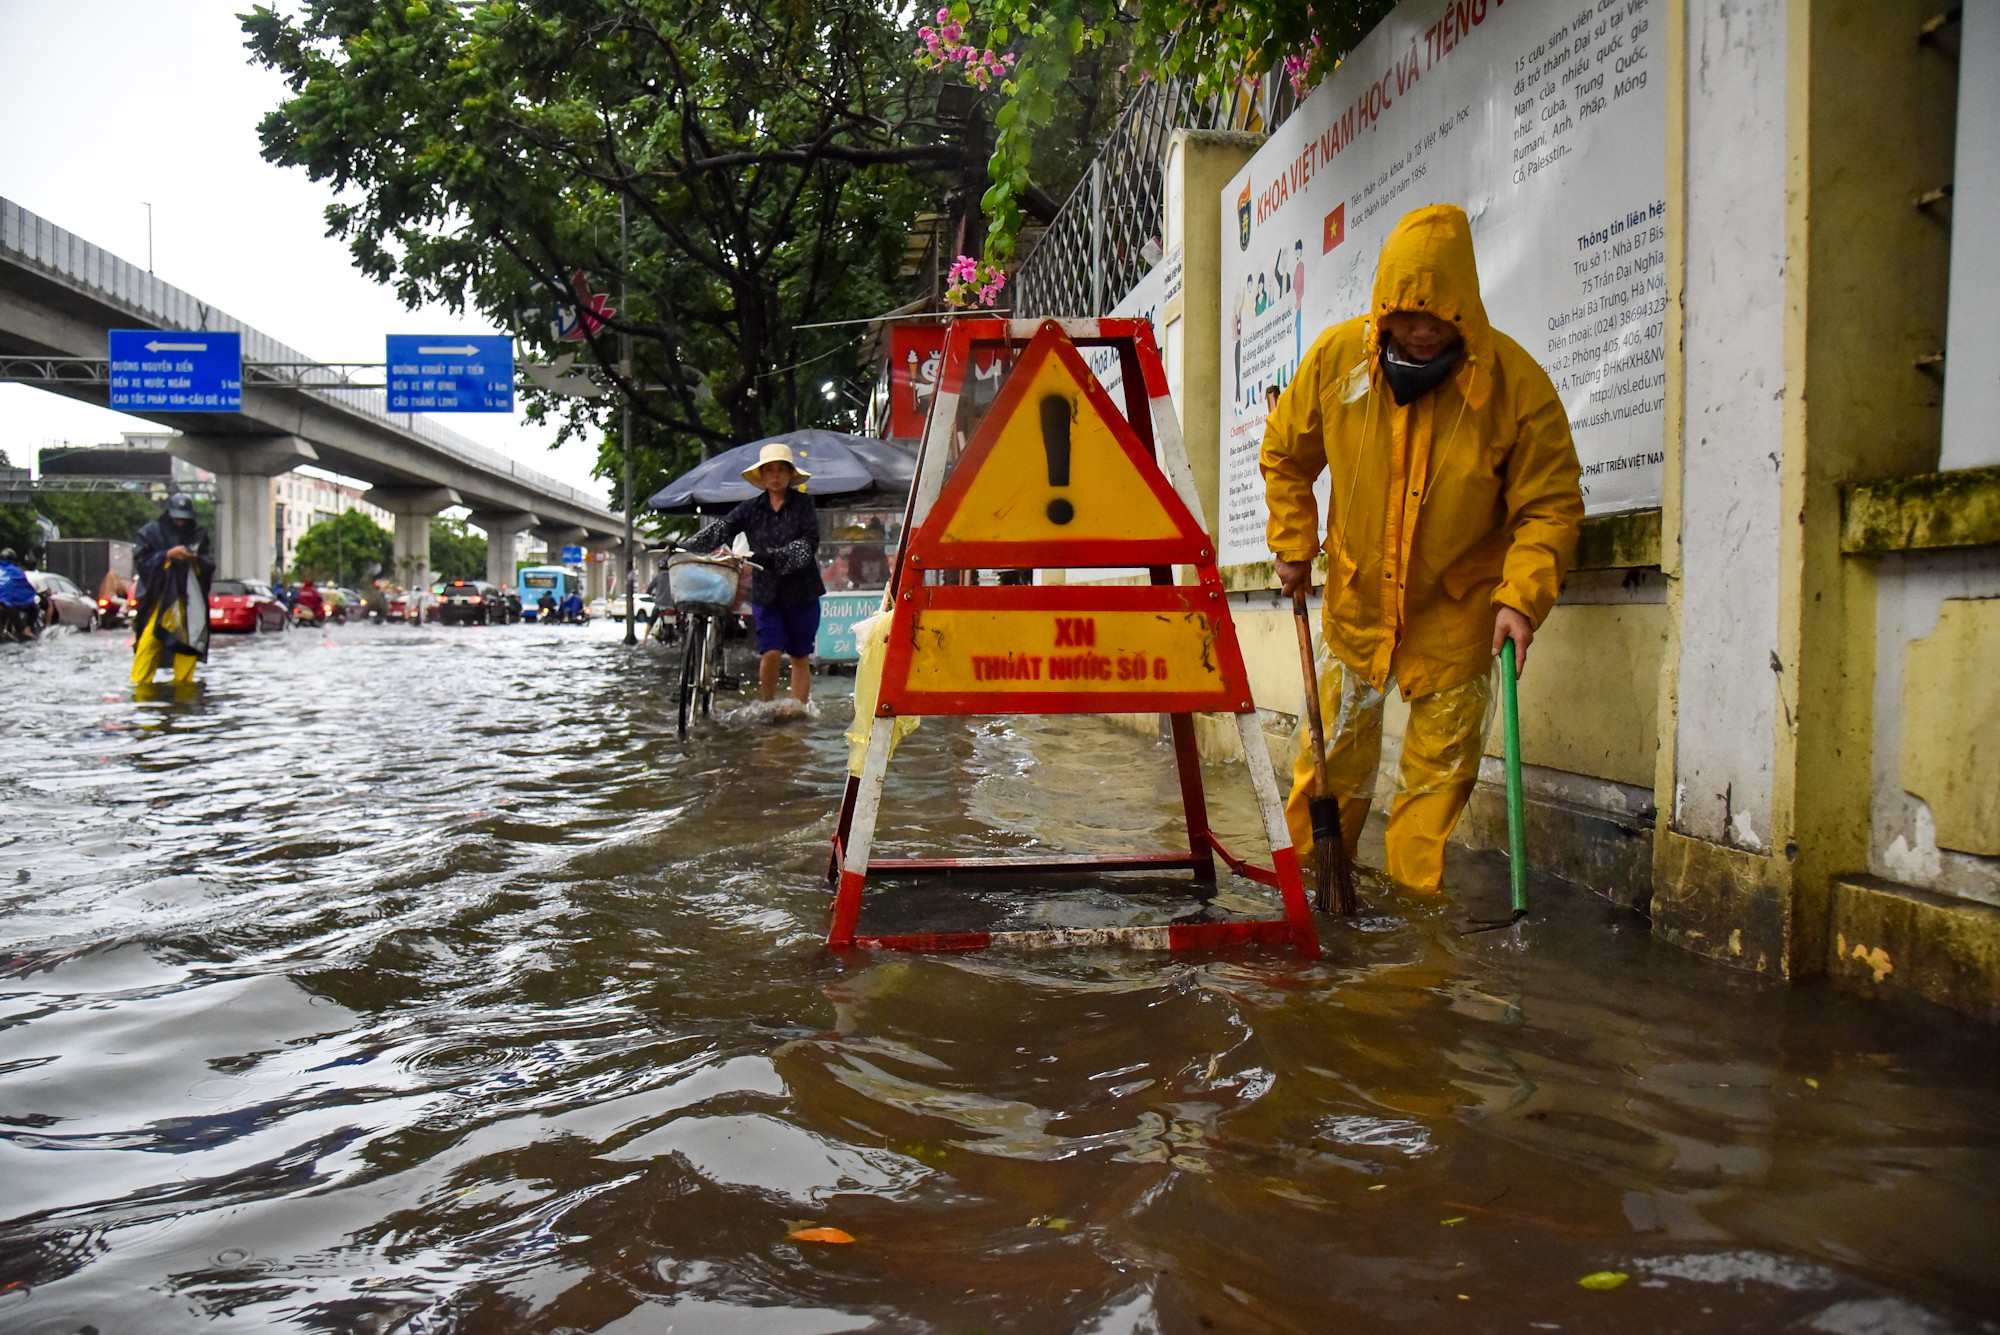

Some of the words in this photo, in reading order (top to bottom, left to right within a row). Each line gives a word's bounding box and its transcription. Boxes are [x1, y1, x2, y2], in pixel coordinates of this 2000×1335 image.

[1514, 53, 1525, 74] 15
[1548, 26, 1568, 49] sinh
[1572, 8, 1593, 31] viên
[1543, 48, 1570, 75] thành
[1574, 30, 1591, 55] Đại
[1610, 8, 1624, 29] tại
[1514, 97, 1534, 119] Nam
[1539, 82, 1556, 101] của
[1596, 34, 1623, 63] quốc
[1630, 19, 1649, 44] gia
[1541, 98, 1567, 122] Cuba,
[1574, 73, 1604, 100] Trung
[1615, 46, 1648, 73] Quốc,
[1257, 172, 1289, 228] KHOA
[1290, 142, 1318, 193] VIỆT
[1320, 106, 1355, 169] NAM
[1358, 67, 1392, 132] HỌC
[1396, 32, 1420, 97] VÀ
[1424, 0, 1488, 71] TIẾNG
[1406, 150, 1413, 164] là
[1423, 131, 1436, 150] Việt
[1456, 105, 1470, 124] học
[1513, 131, 1548, 163] Rumani,
[1552, 115, 1574, 138] Anh,
[1579, 96, 1607, 121] Pháp,
[1613, 70, 1648, 100] Mông
[1527, 143, 1573, 177] Palesstin...
[1350, 216, 1364, 230] được
[1364, 200, 1380, 218] thành
[1380, 193, 1389, 208] lập
[1577, 229, 1609, 251] Thông
[1610, 220, 1625, 236] tin
[1626, 210, 1647, 229] liên
[1648, 199, 1666, 219] hệ:
[1573, 260, 1588, 275] Trụ
[1603, 249, 1611, 262] 1:
[1612, 238, 1632, 259] Nhà
[1634, 231, 1647, 250] B7
[1582, 279, 1592, 295] 75
[1616, 262, 1632, 280] Đại
[1547, 313, 1570, 331] Quận
[1571, 304, 1586, 322] Hai
[1587, 299, 1598, 316] Bà
[1599, 290, 1629, 310] Trưng,
[1631, 281, 1645, 299] Hà
[1646, 273, 1667, 293] Nội.
[1548, 334, 1567, 353] Điện
[1568, 324, 1592, 344] thoại:
[1594, 314, 1618, 337] (024)
[1619, 297, 1666, 327] 38694323
[1563, 356, 1571, 369] 2:
[1572, 345, 1601, 366] Phòng
[1602, 337, 1621, 354] 405,
[1622, 330, 1642, 348] 406,
[1643, 322, 1664, 341] 407
[495, 382, 508, 391] km
[1561, 377, 1570, 392] A,
[1571, 369, 1601, 388] Trường
[1603, 346, 1665, 378] ĐHKHXH&NV
[1589, 372, 1666, 405] http://vsl.edu.vn
[495, 398, 508, 407] km
[1585, 460, 1604, 477] PHÁT
[1606, 455, 1627, 473] TRIỂN
[1627, 453, 1646, 470] VIỆT
[822, 600, 853, 618] Bánh
[856, 600, 875, 618] Mỳ
[1054, 617, 1096, 647] XN
[971, 652, 1043, 681] THOÁT
[1048, 651, 1113, 681] NƯỚC
